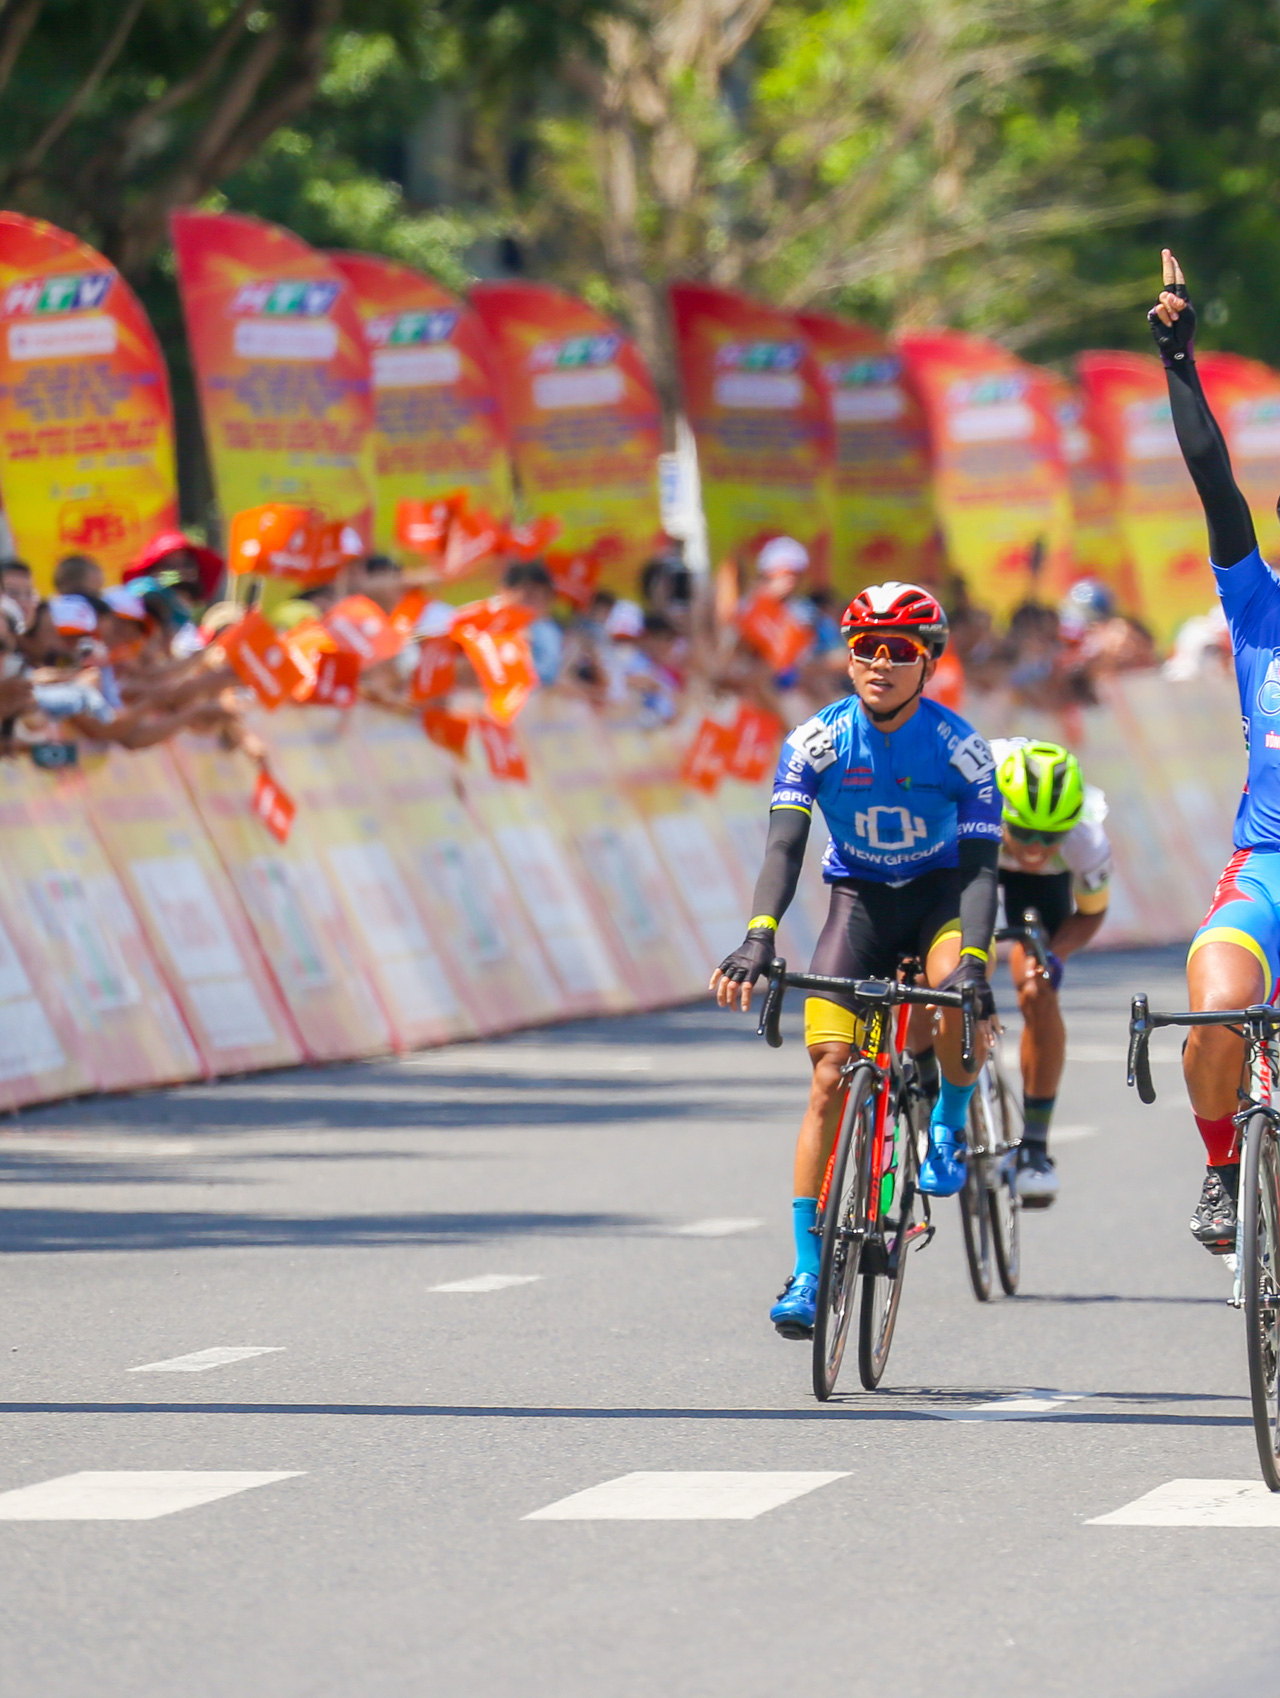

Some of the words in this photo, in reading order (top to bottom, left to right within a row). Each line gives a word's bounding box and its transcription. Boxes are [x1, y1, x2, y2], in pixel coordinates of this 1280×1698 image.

[3, 271, 114, 318] HTV
[228, 280, 342, 318] HTV
[803, 727, 834, 760] 13
[961, 739, 995, 771] 13
[844, 840, 945, 866] NEWGROUP
